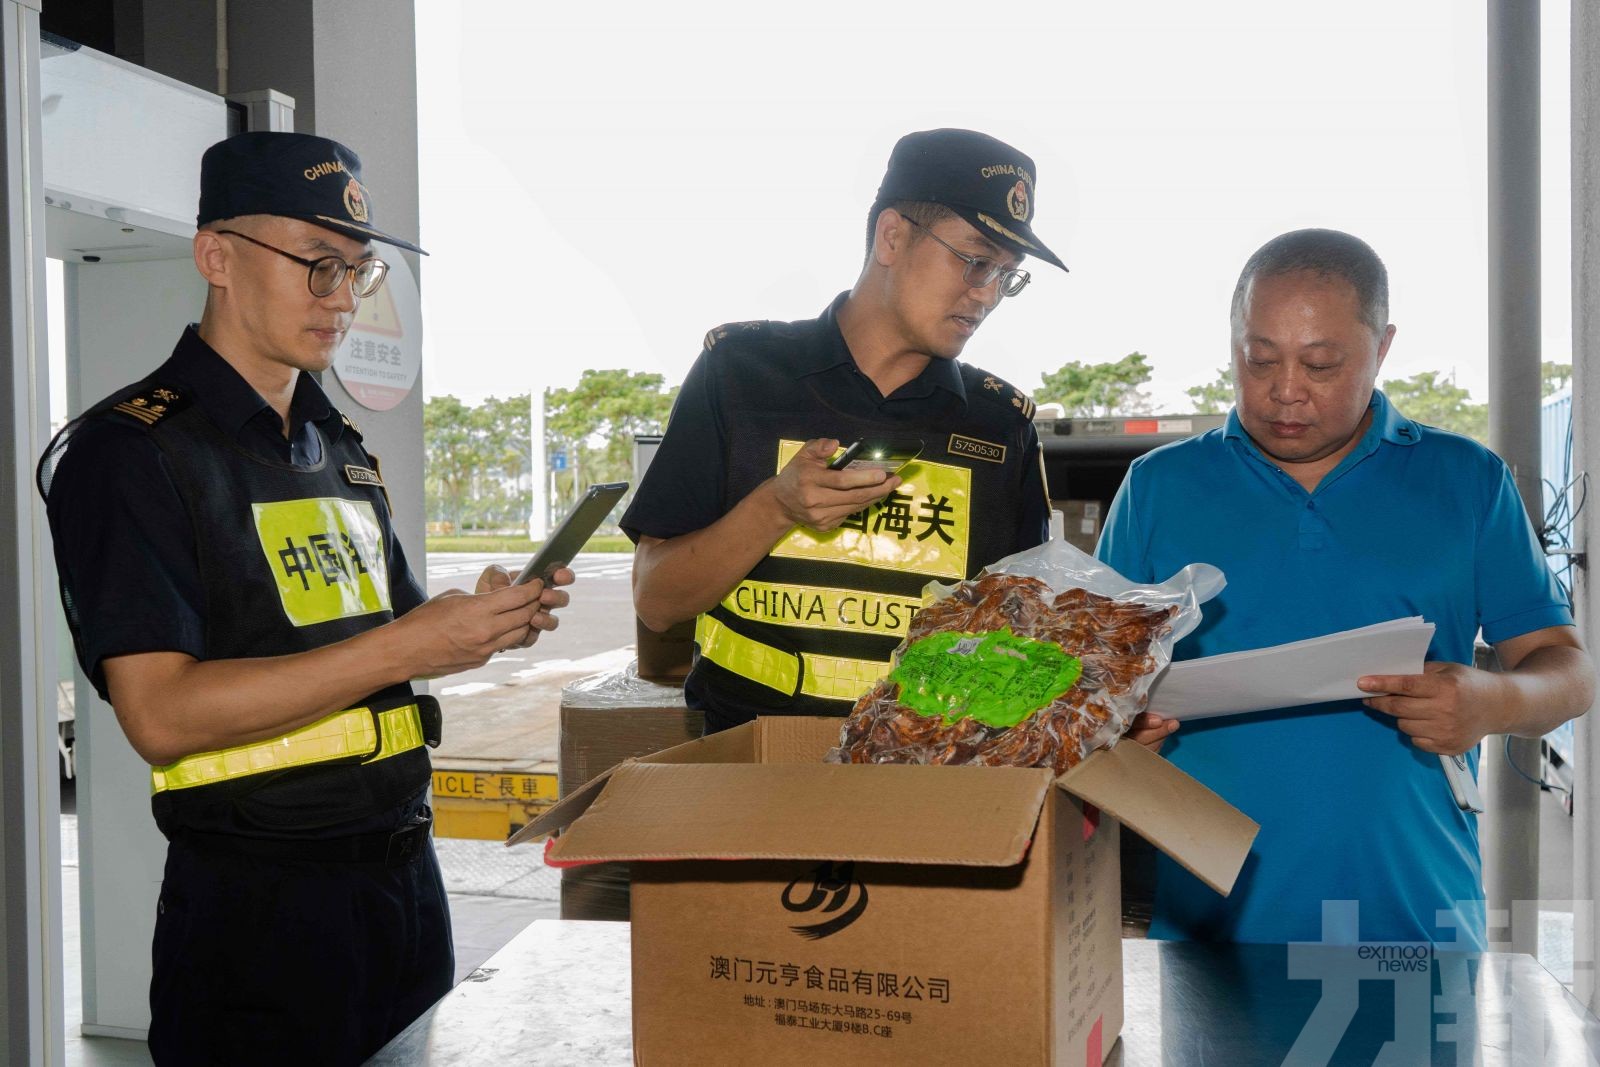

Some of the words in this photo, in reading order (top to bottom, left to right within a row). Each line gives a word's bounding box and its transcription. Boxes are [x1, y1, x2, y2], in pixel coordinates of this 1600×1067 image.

[304, 161, 346, 180] CHINA
[981, 164, 1016, 178] CHINA
[350, 337, 402, 366] 注意安全
[955, 439, 1000, 458] 5750530
[736, 586, 827, 622] CHINA
[432, 776, 485, 794] ICLE
[499, 777, 539, 797] 長車
[709, 955, 951, 1004] 澳门元亨食品有限公司
